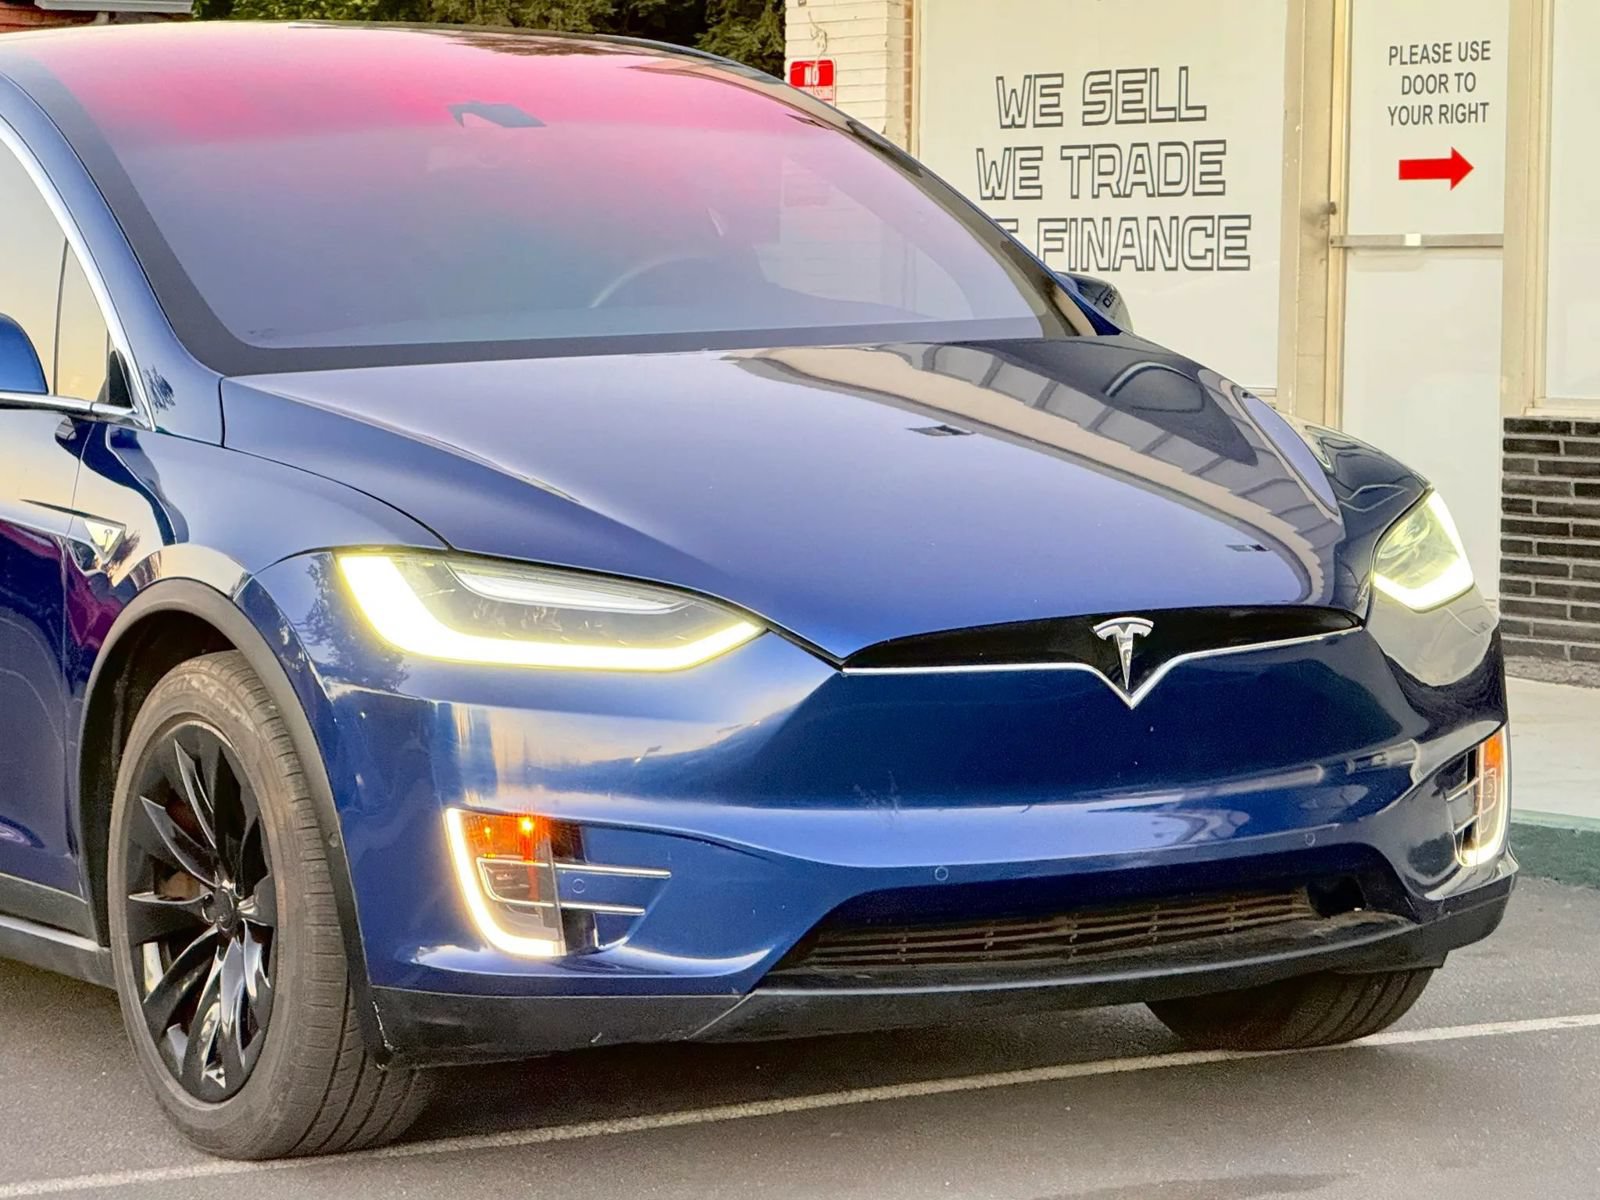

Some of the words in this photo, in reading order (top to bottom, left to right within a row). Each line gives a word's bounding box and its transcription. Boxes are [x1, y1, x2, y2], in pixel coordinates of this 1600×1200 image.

[1388, 42, 1453, 66] PLEASE
[1458, 40, 1491, 63] USE
[804, 66, 820, 86] NO
[1401, 73, 1449, 95] DOOR
[1454, 72, 1477, 93] TO
[995, 73, 1065, 129] WE
[1082, 66, 1207, 127] SELL
[1387, 104, 1433, 126] YOUR
[1438, 102, 1490, 125] RIGHT
[976, 146, 1044, 200] WE
[1060, 139, 1227, 199] TRADE
[1037, 214, 1252, 272] FINANCE
